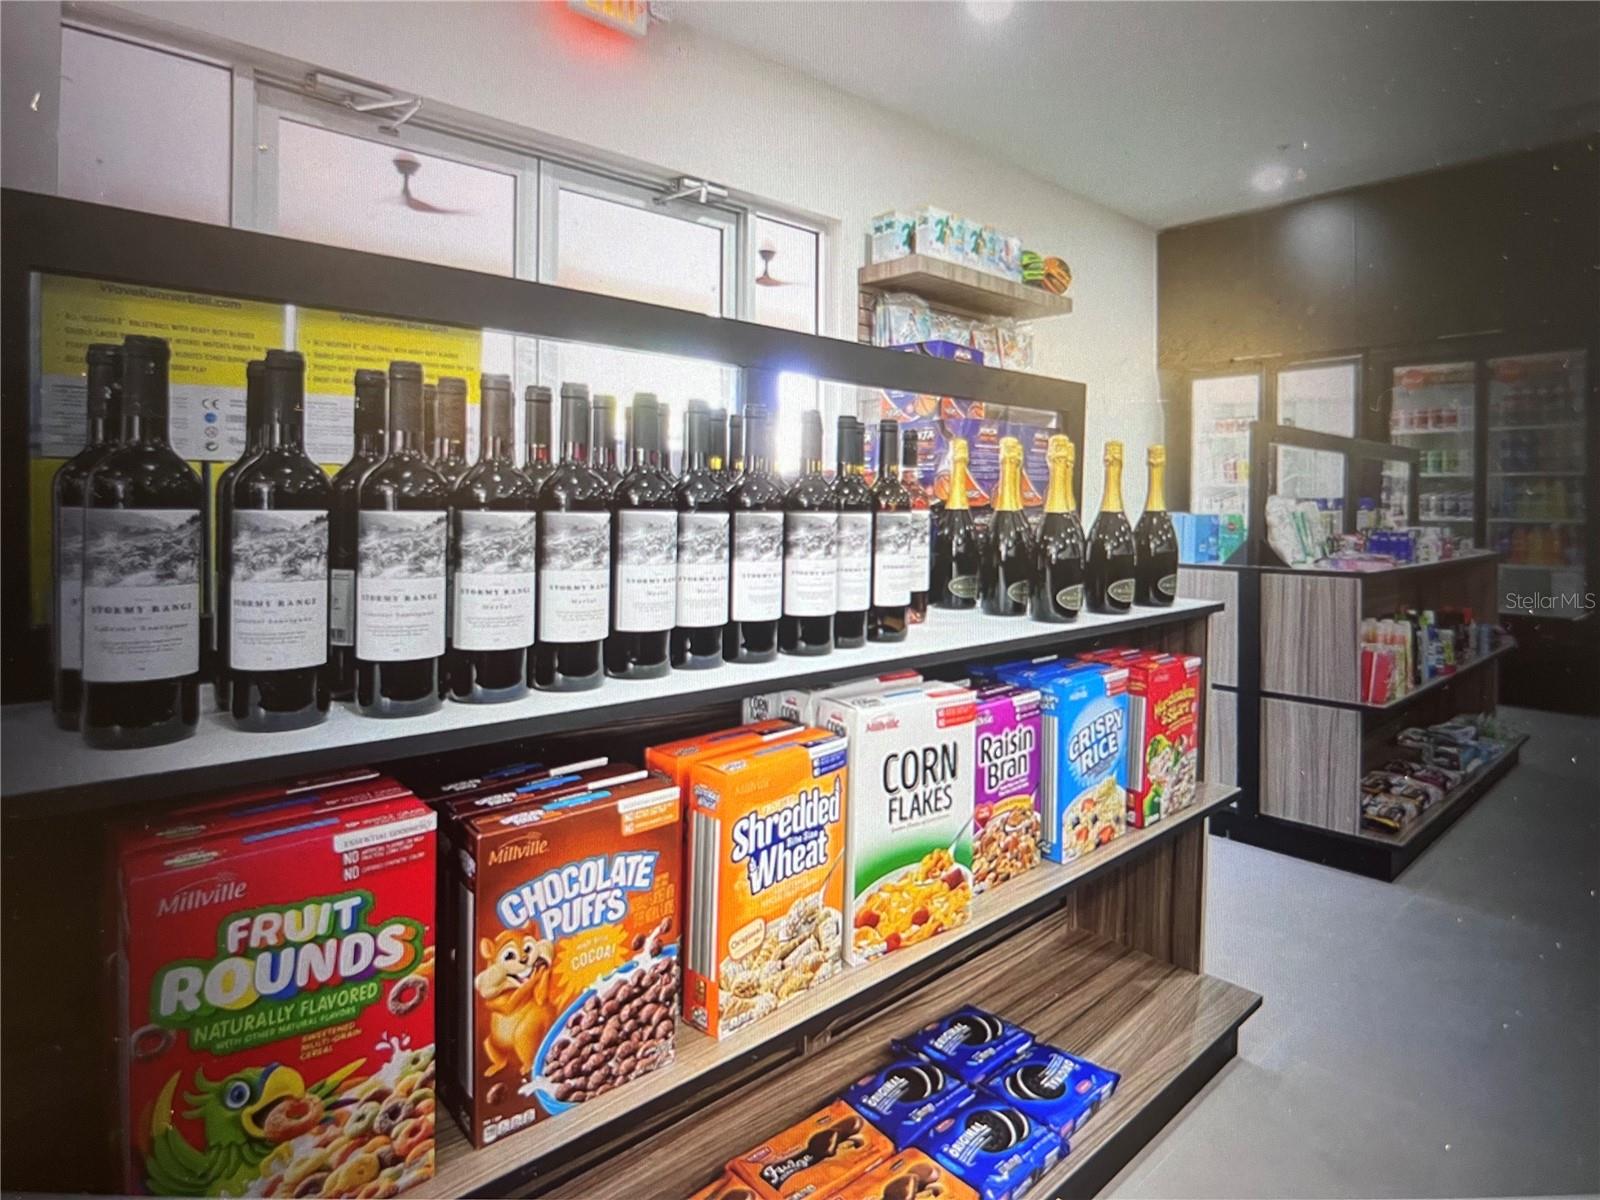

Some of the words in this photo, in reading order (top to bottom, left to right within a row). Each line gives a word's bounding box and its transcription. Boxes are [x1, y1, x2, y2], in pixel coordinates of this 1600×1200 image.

[91, 605, 144, 615] STORMY
[980, 727, 1034, 764] Raisin
[1068, 708, 1125, 763] CRISPY
[1078, 732, 1119, 777] RICE
[882, 740, 958, 795] CORN
[987, 753, 1029, 791] Bran
[731, 774, 841, 862] Shredded
[887, 783, 953, 825] FLAKES
[343, 850, 360, 866] NO
[343, 865, 360, 881] NO
[488, 839, 549, 867] Millville
[748, 829, 828, 895] Wheat
[156, 880, 248, 917] Millville
[498, 851, 658, 930] CHOCOLATE
[226, 894, 363, 955] FRUIT
[540, 887, 628, 942] PUFFS
[159, 922, 414, 1019] ROUNDS
[569, 943, 618, 971] COCOA!
[193, 1002, 297, 1045] NATURALLY
[299, 981, 380, 1019] FLAVORED
[867, 1075, 907, 1106] ORIGINAL
[948, 1121, 989, 1159] ORIGINAL
[762, 1153, 815, 1185] Fudge
